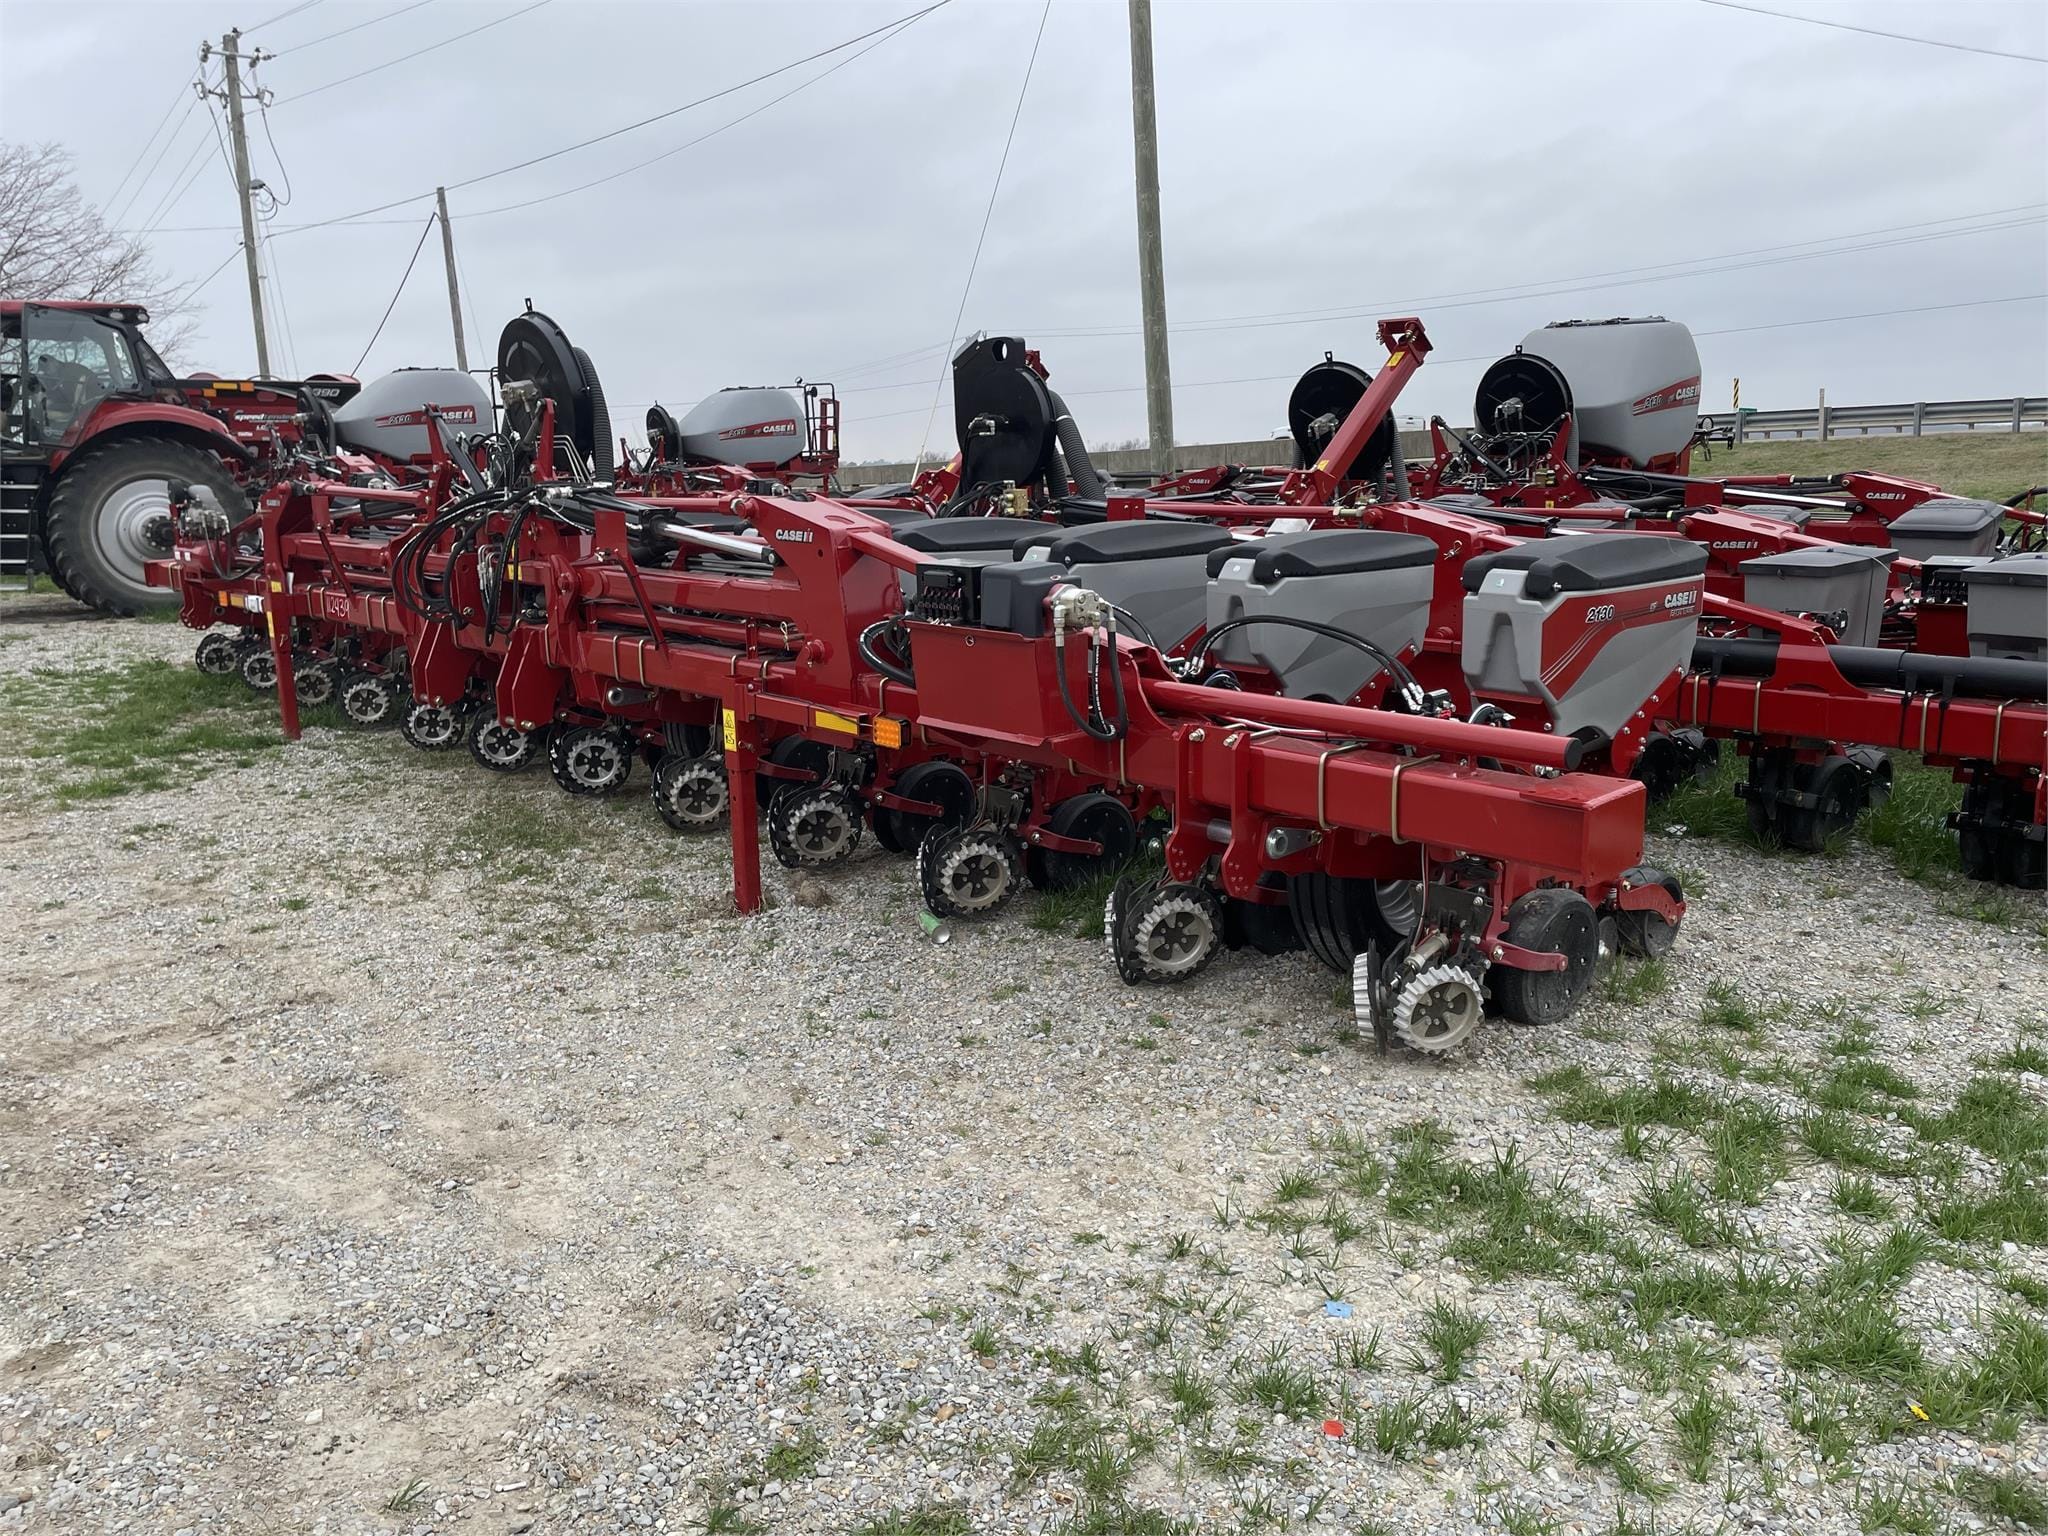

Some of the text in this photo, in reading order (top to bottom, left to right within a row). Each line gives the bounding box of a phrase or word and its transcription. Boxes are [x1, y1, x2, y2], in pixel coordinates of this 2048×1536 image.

[1676, 386, 1695, 401] CASE
[763, 425, 786, 433] CASE
[1865, 492, 1896, 500] CASE
[775, 529, 803, 542] CASE
[1712, 541, 1746, 549] CASE
[1584, 604, 1616, 624] 2130
[1664, 592, 1689, 609] CASE
